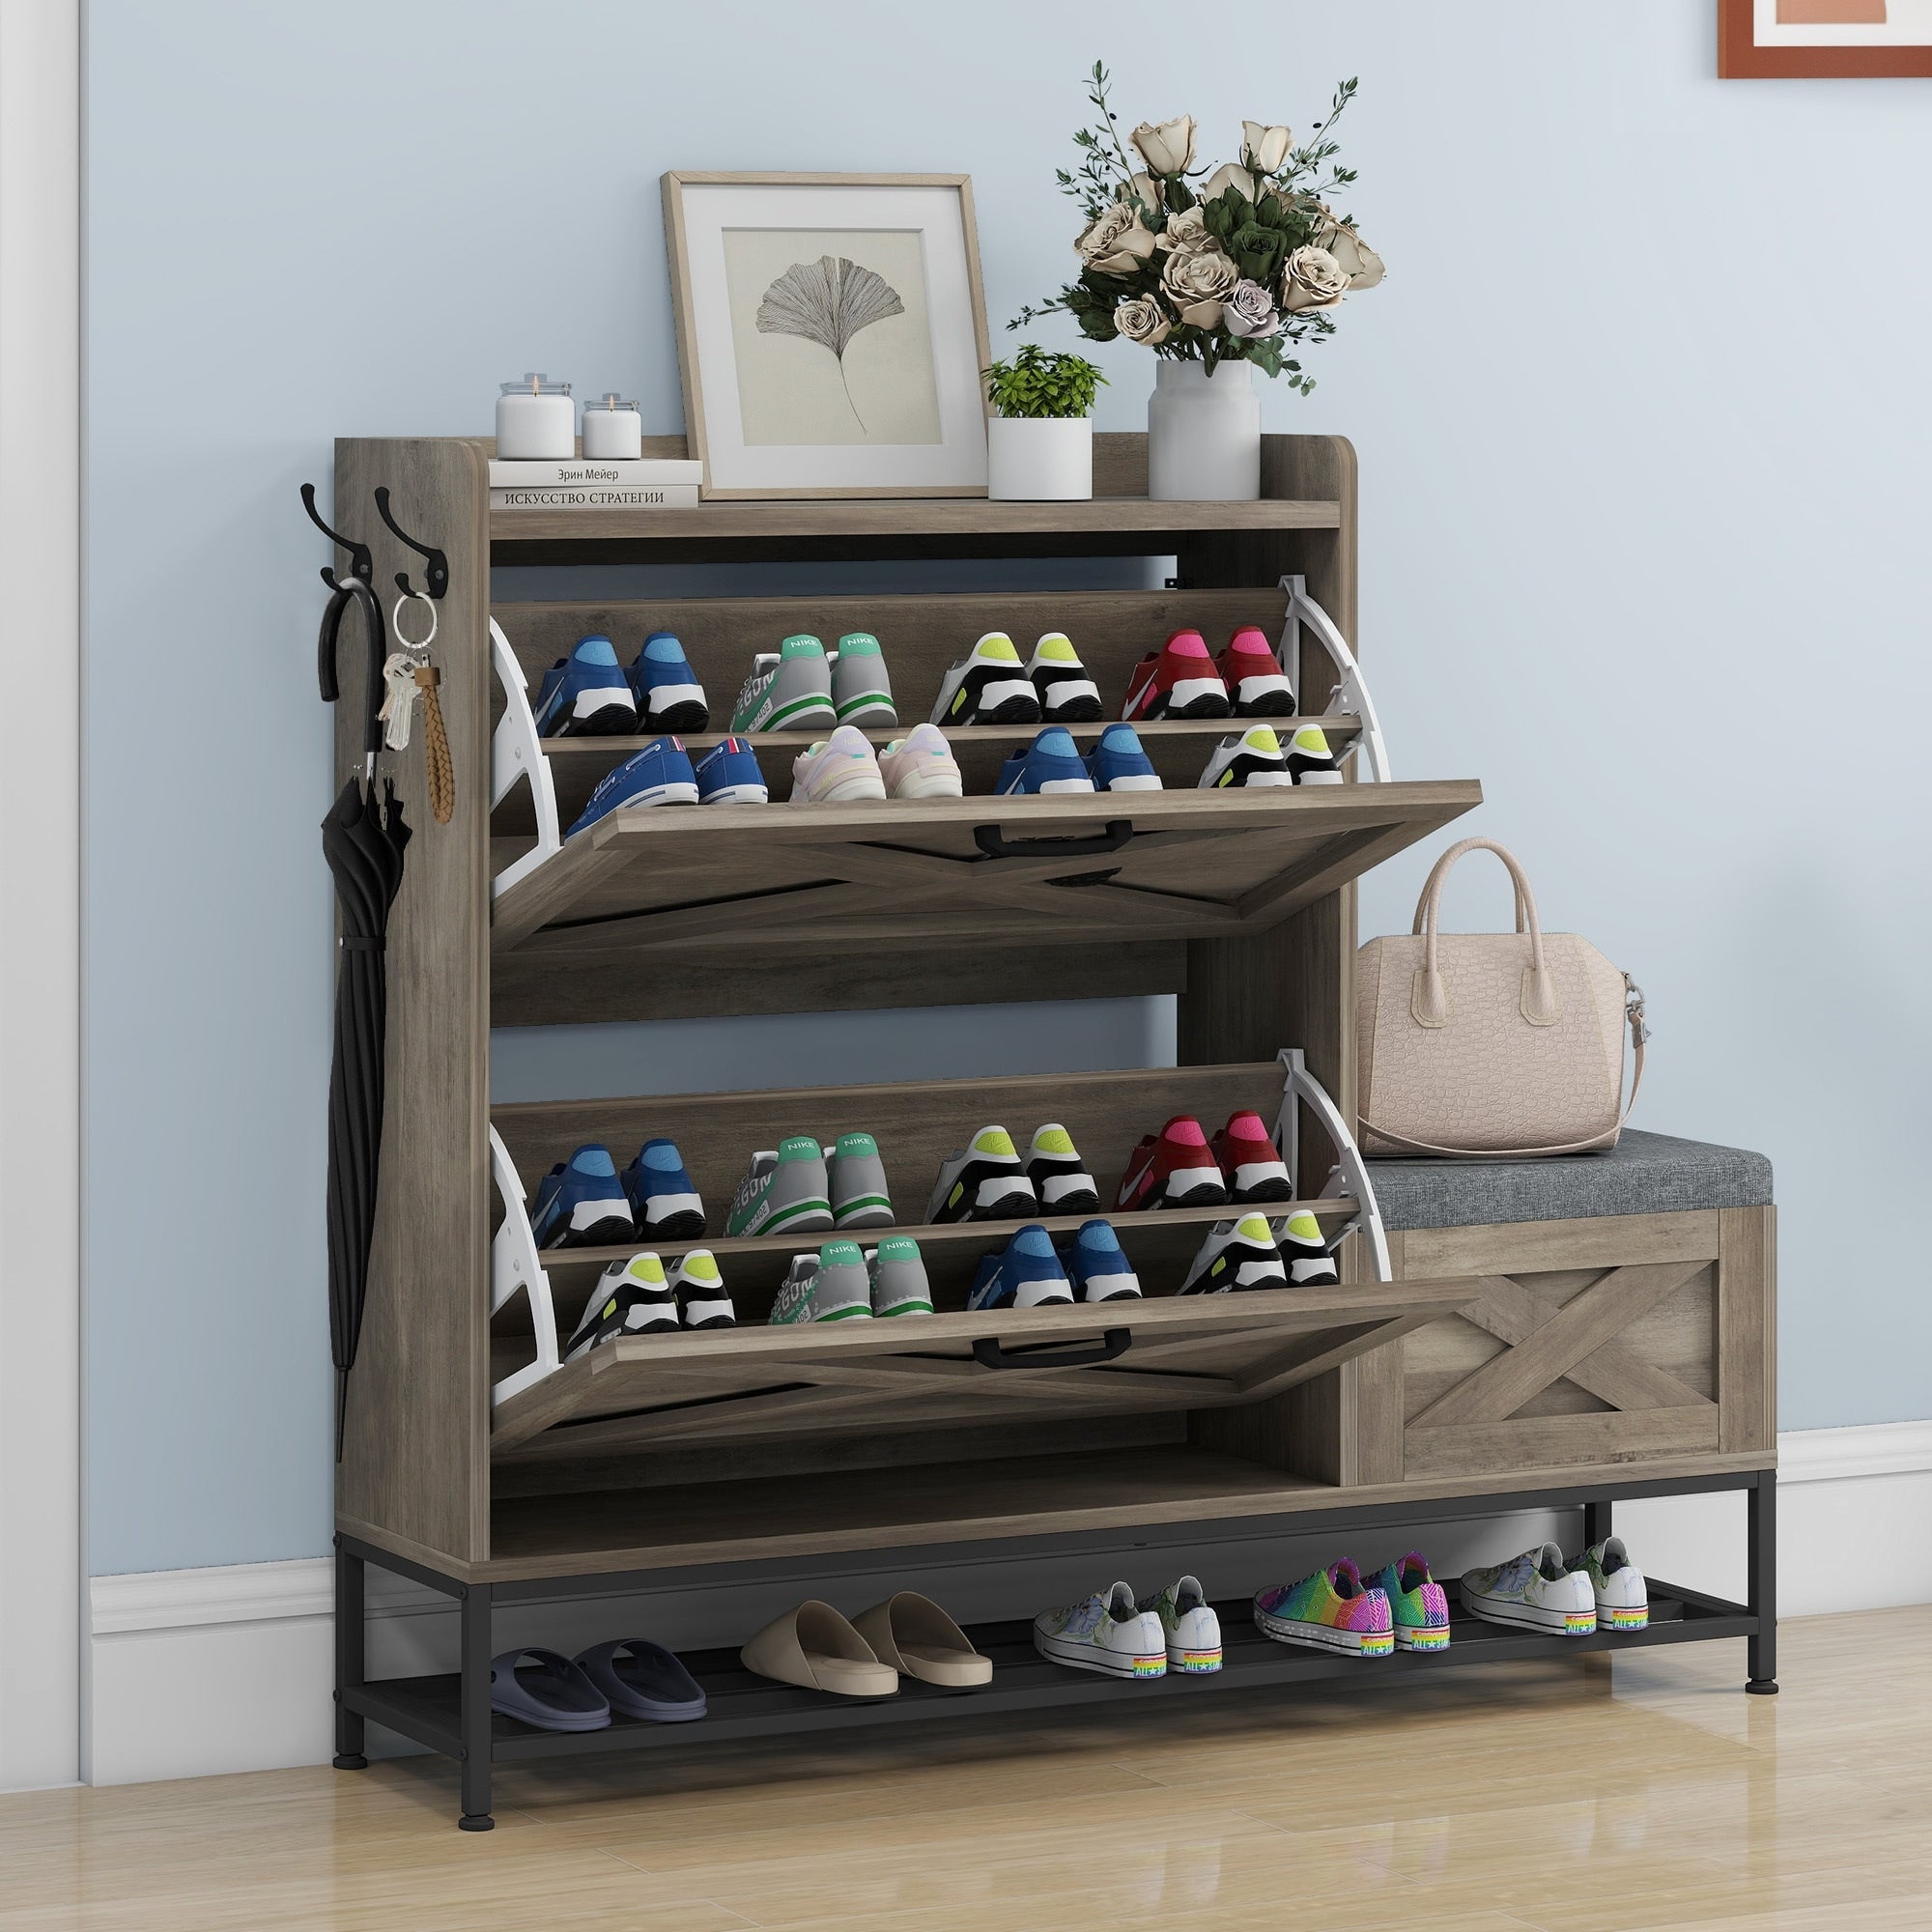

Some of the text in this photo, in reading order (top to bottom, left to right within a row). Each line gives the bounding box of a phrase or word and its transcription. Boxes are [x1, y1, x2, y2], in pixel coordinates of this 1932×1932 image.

[557, 468, 619, 482] Эрин Мейер
[504, 492, 665, 504] ИСКУССТВО СТРАТЕГИИ
[790, 639, 819, 648] NIKE
[847, 638, 874, 646] NIKE
[787, 1142, 815, 1151] NIKE
[844, 1138, 871, 1147] NIKE
[829, 1245, 857, 1255] NIKE
[886, 1241, 913, 1250] NIKE
[1567, 1623, 1580, 1634] ALL
[1614, 1618, 1627, 1629] ALL
[1413, 1639, 1427, 1649] ALL
[1363, 1645, 1376, 1655] ALL
[1135, 1666, 1149, 1676] ALL
[1185, 1662, 1199, 1671] ALL
